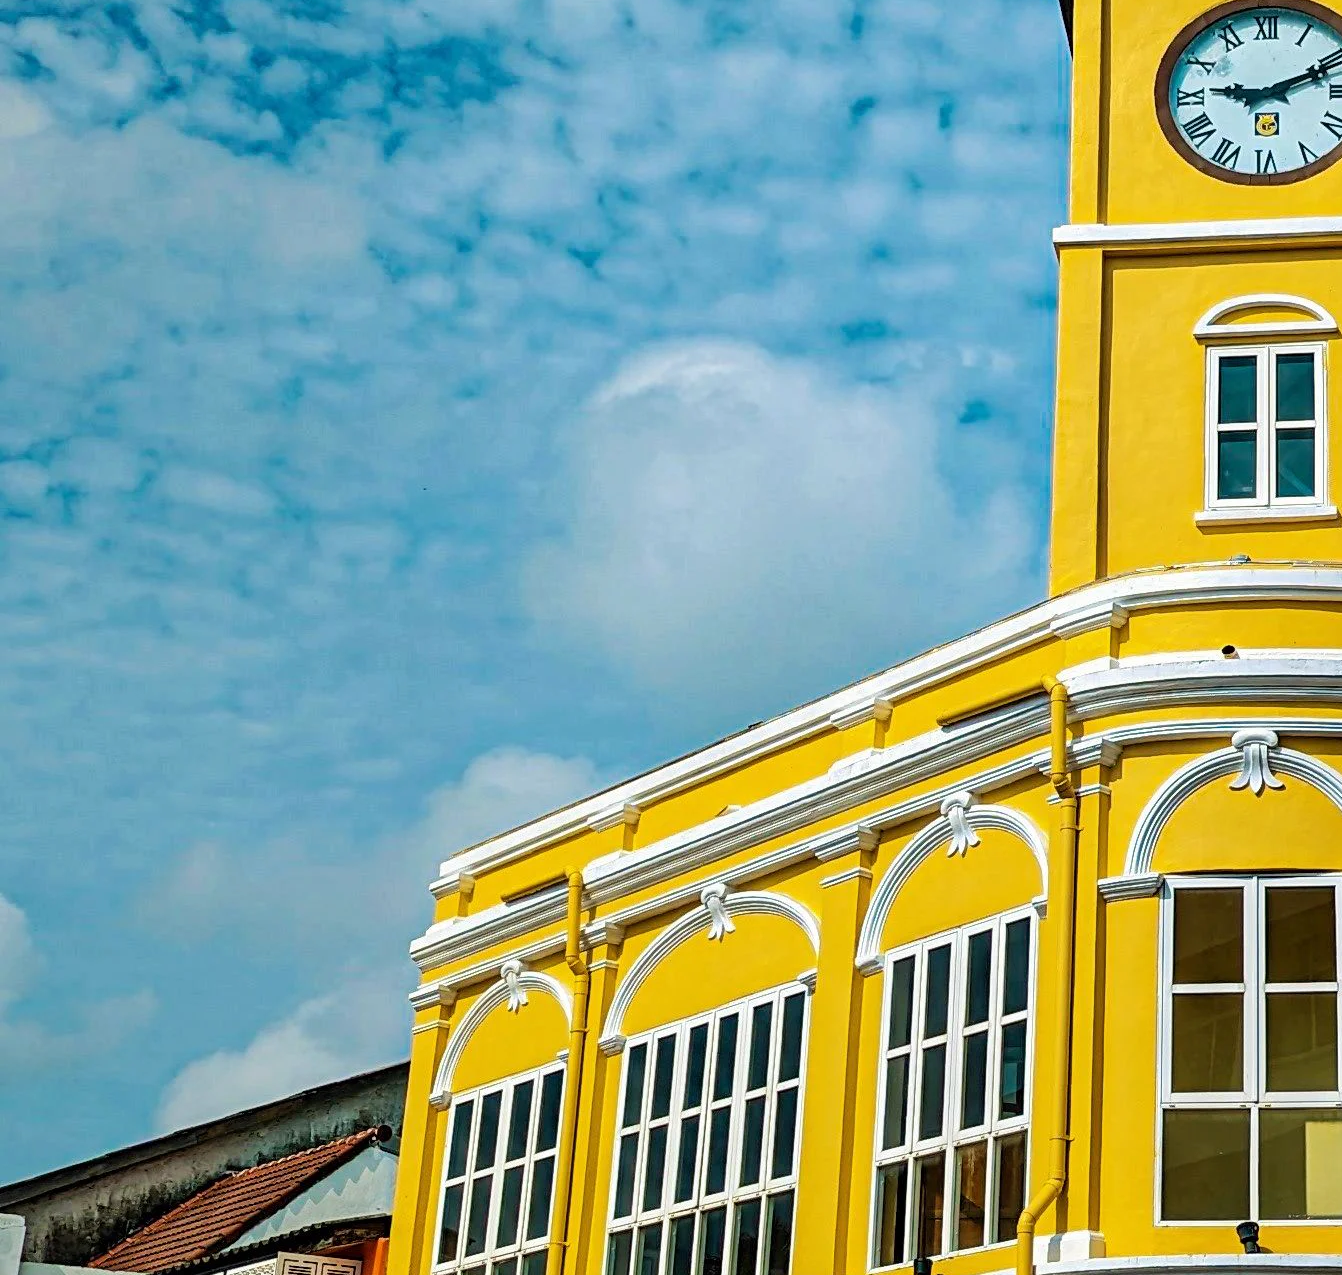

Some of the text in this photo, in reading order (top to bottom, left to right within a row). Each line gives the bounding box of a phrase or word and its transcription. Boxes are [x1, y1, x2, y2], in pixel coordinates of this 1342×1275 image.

[1218, 22, 1244, 53] XI
[1253, 16, 1279, 40] XII
[1295, 23, 1315, 47] I
[1186, 57, 1217, 75] X
[1177, 87, 1205, 107] IX
[1181, 112, 1217, 150] VIII
[1209, 137, 1242, 172] VII
[1254, 149, 1278, 174] VI
[1298, 140, 1319, 165] V
